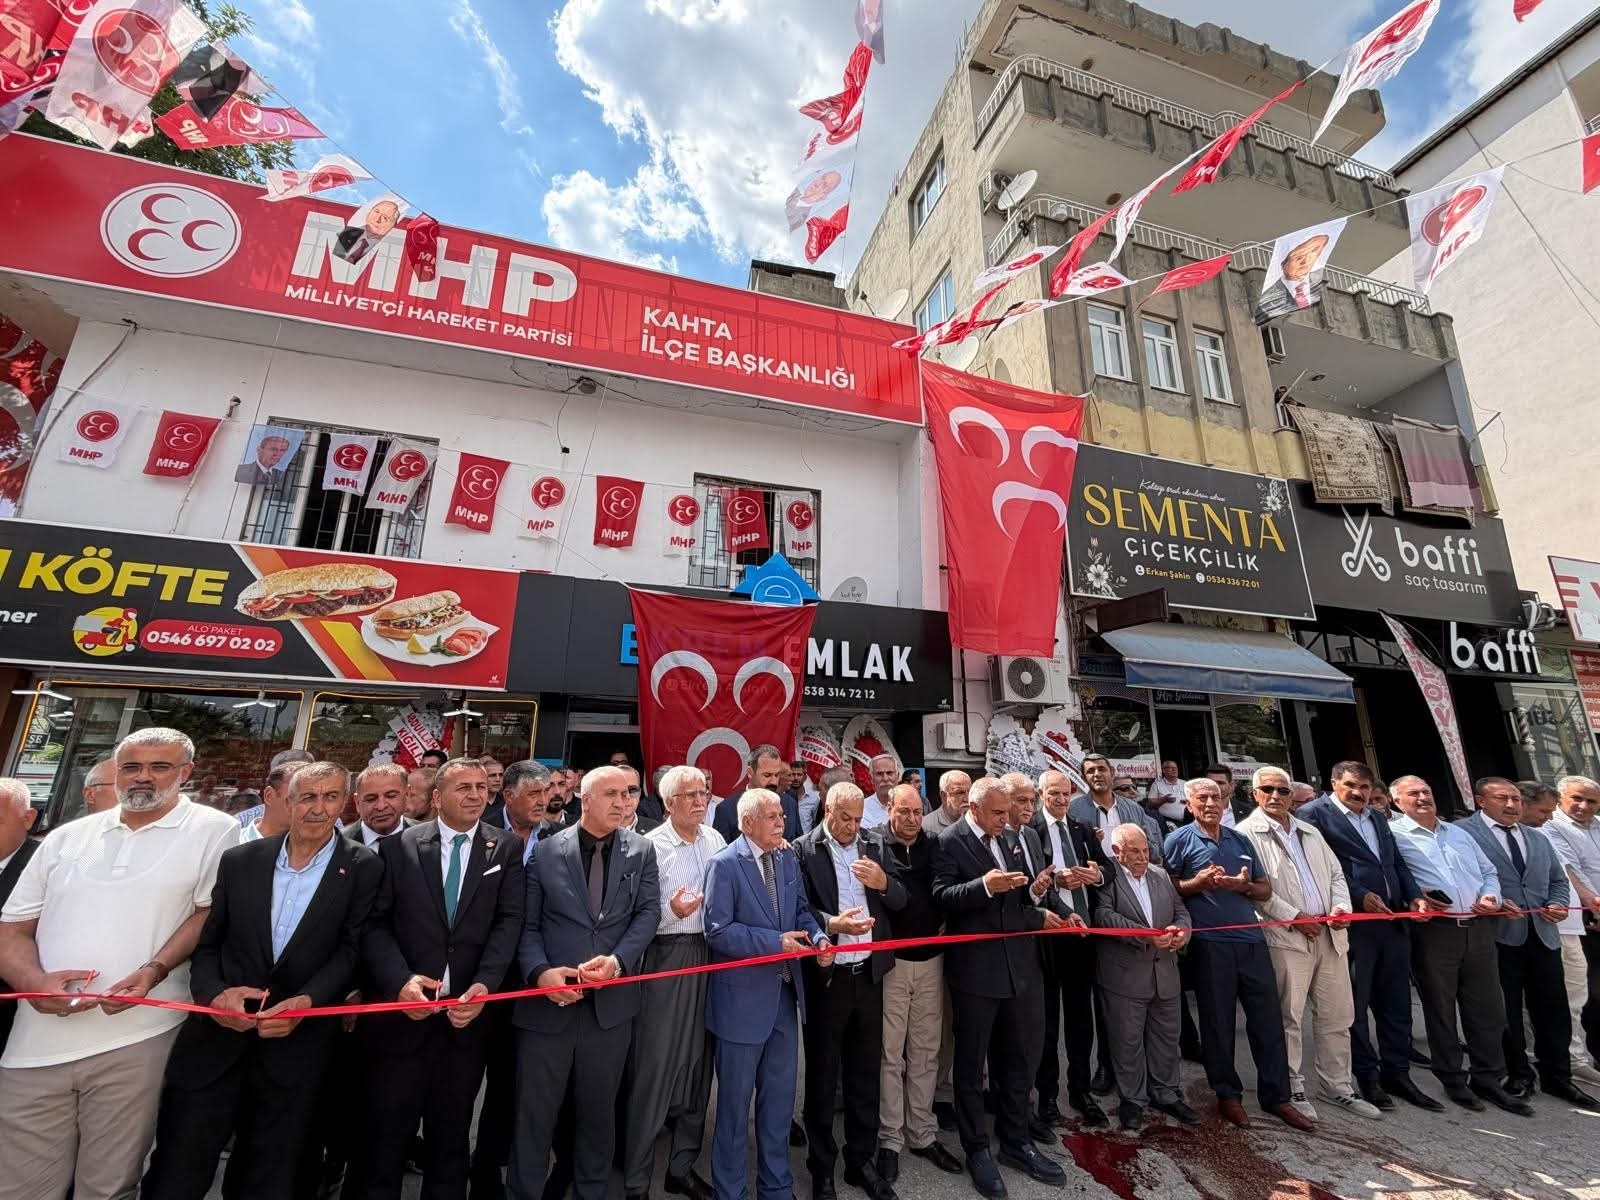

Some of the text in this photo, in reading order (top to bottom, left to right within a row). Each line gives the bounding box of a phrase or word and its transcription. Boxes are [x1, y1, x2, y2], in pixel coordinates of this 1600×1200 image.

[290, 211, 578, 317] MHP
[284, 284, 573, 347] MİLLİYETÇİ HAREKET PARTİSİ
[643, 306, 733, 341] KAHTA
[641, 328, 855, 390] İLÇE BAŞKANLIĞI
[68, 447, 104, 461] MHP
[156, 457, 190, 470] MHP
[376, 491, 408, 505] MHP
[454, 505, 489, 524] MHP
[1083, 484, 1286, 552] SEMENTA
[601, 528, 629, 541] MHP
[669, 535, 696, 549] MHP
[731, 532, 761, 546] MHP
[1124, 537, 1260, 572] ÇİÇEKÇİLİK
[1394, 526, 1483, 576] baffi
[18, 546, 229, 605] KÖFTE
[1145, 567, 1191, 580] Erkan Şahin
[1206, 575, 1261, 589] 0534 336 72 01
[1405, 573, 1488, 595] saç tasarım
[212, 625, 245, 636] PAKET
[147, 631, 276, 652] 0546 697 02 02
[1450, 621, 1542, 674] baffi
[828, 687, 846, 698] 314
[849, 688, 862, 698] 72
[864, 690, 875, 699] 12
